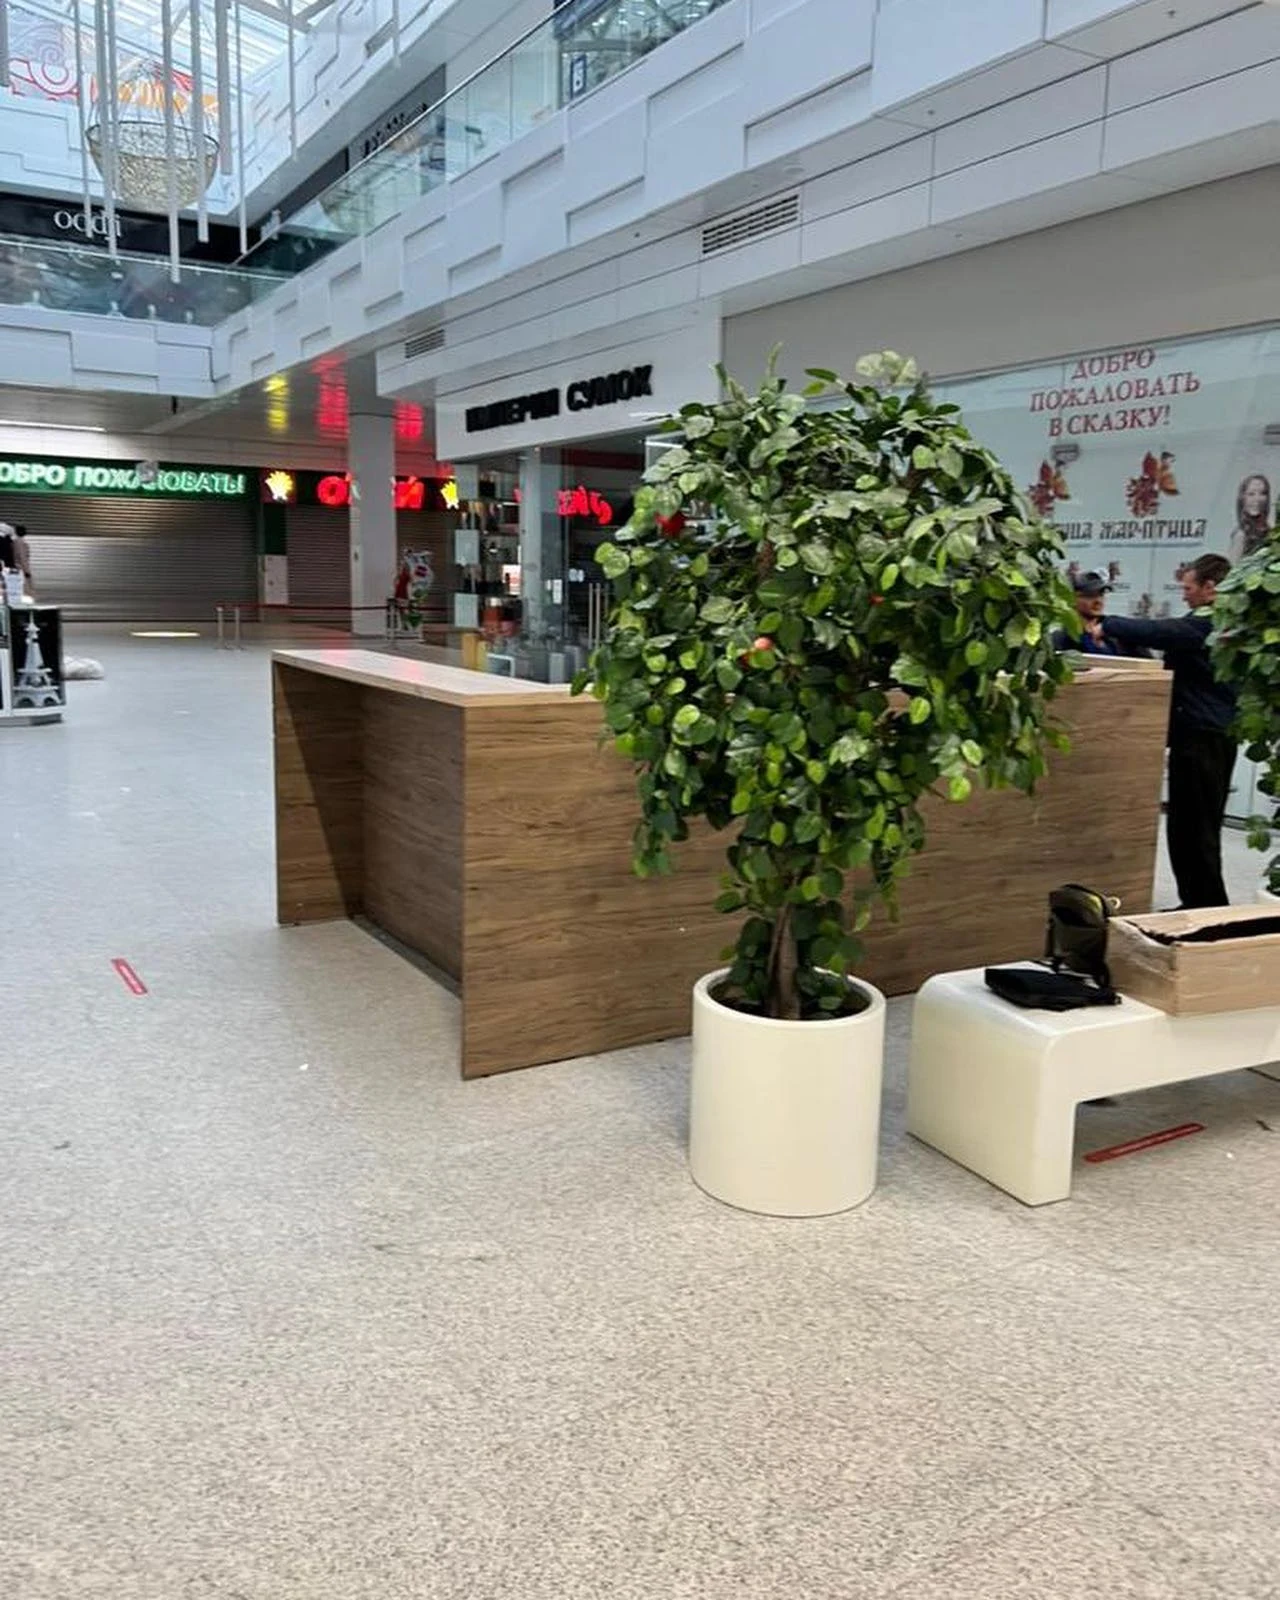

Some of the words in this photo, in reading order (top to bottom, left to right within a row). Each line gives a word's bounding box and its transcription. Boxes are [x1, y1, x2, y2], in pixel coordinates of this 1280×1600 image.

[1071, 347, 1156, 380] ДОБРО
[566, 364, 653, 412] СУМОК
[1029, 371, 1200, 412] ПОЖАЛОВАТЬ
[1048, 417, 1063, 437] В
[1066, 404, 1171, 435] СКАЗКУ!
[1100, 519, 1207, 540] ЖАР-ПТИЦА
